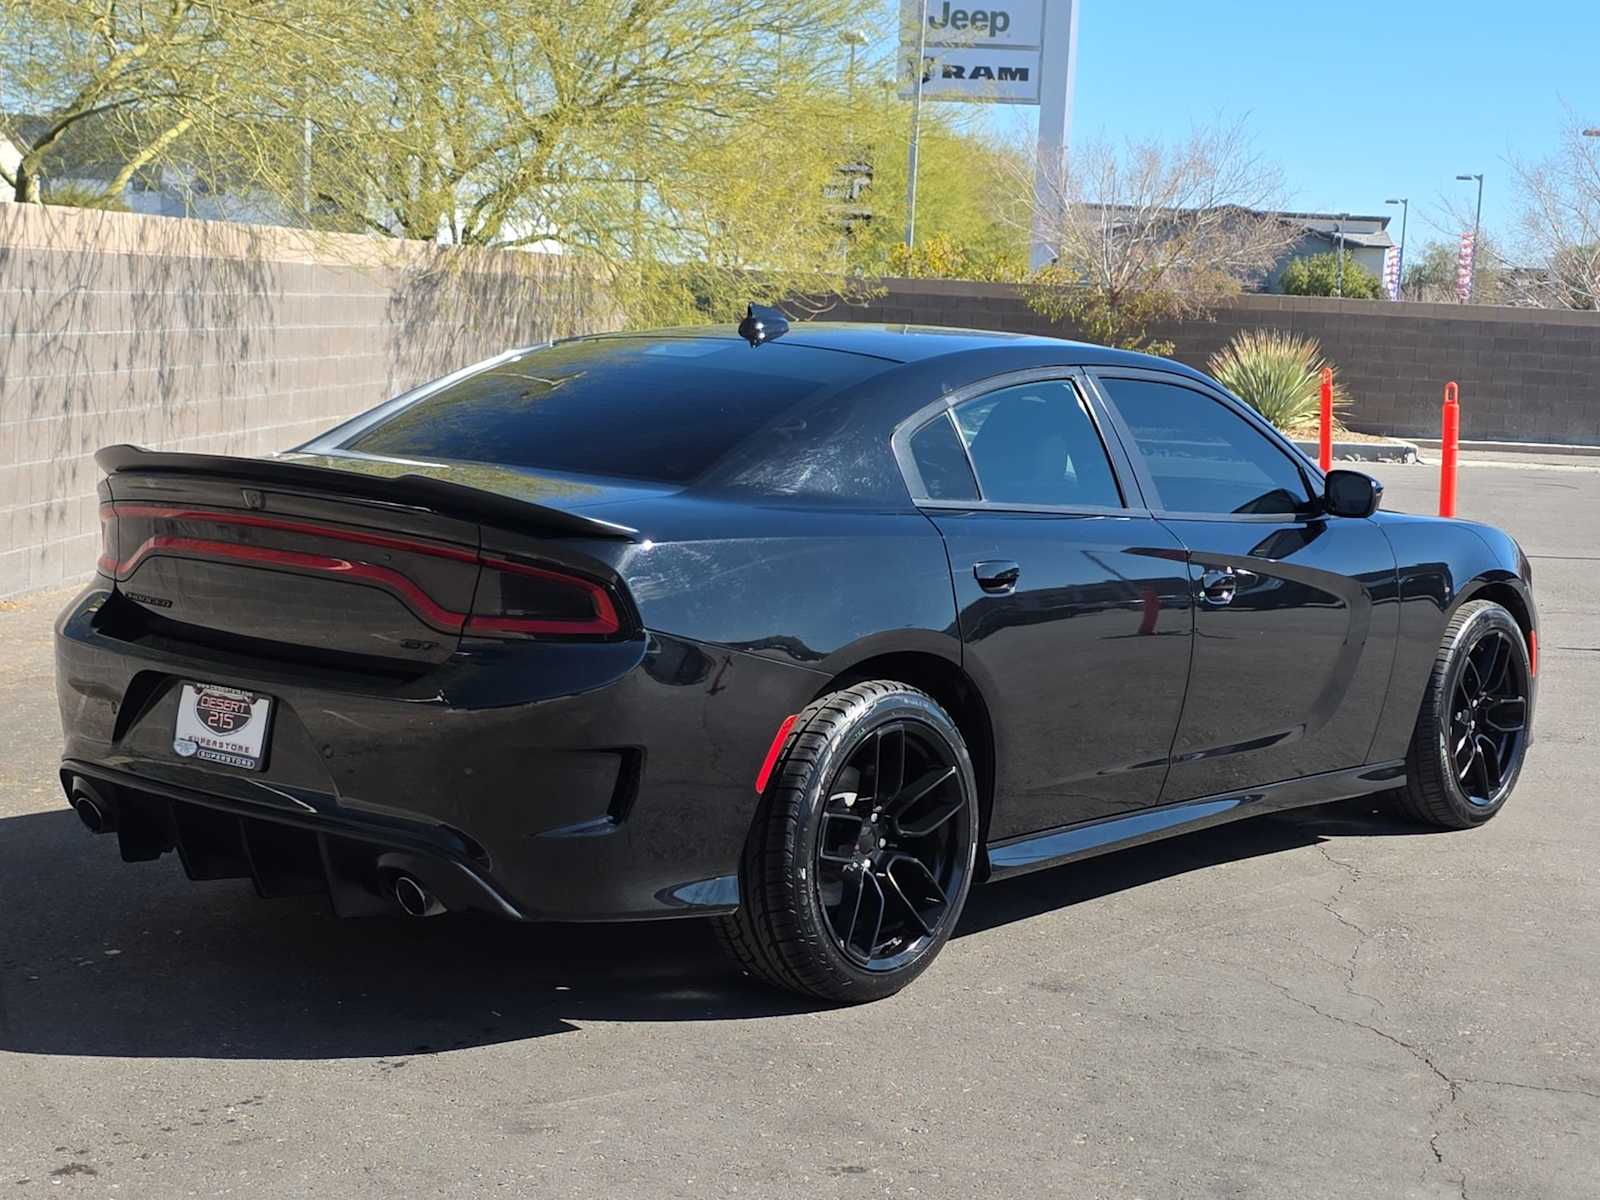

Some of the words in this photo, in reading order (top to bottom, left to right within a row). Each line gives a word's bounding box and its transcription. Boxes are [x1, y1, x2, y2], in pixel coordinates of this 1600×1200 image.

[928, 1, 1010, 37] Jeep
[942, 65, 1029, 81] RAM
[201, 696, 248, 713] DESERT
[207, 711, 234, 729] 215
